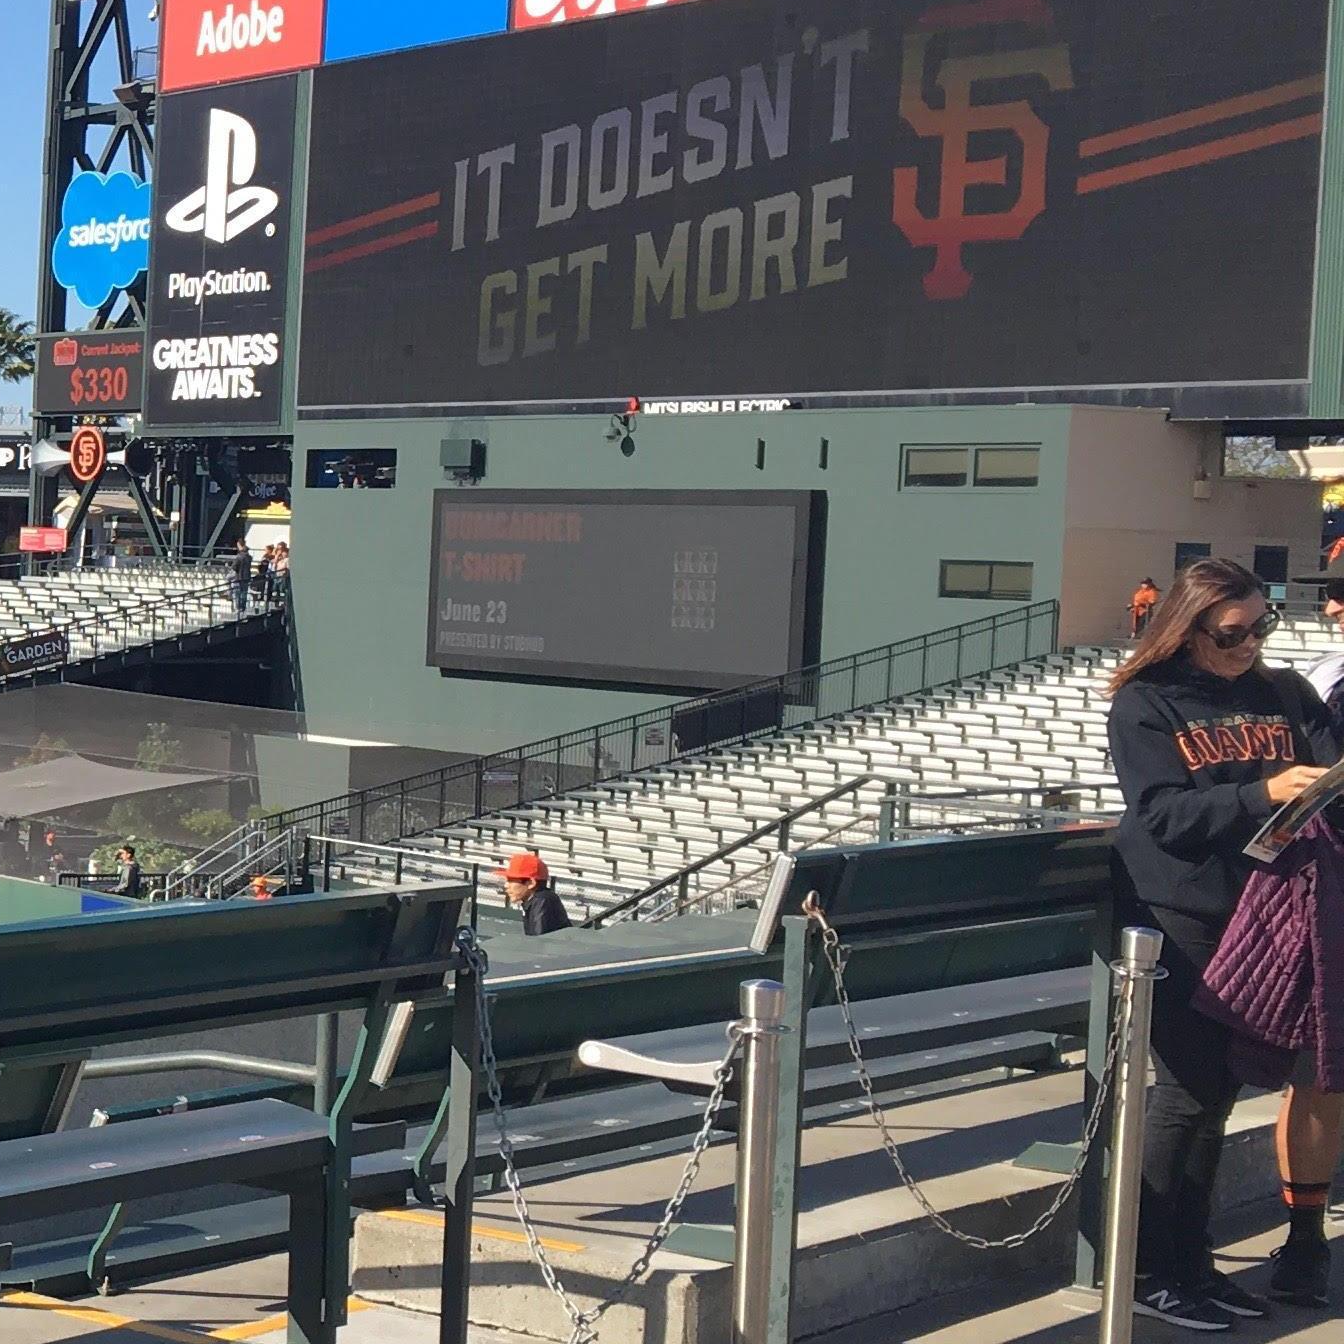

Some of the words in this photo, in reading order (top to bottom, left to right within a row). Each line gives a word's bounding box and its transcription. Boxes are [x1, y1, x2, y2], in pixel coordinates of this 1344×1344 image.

[450, 144, 515, 252] IT
[537, 27, 870, 230] DOESN'T
[69, 213, 150, 252] salesforc
[476, 244, 608, 367] GET
[631, 175, 854, 330] MORE
[153, 332, 278, 370] GREATNESS
[70, 366, 128, 405] $330
[441, 598, 481, 623] June
[486, 600, 508, 624] 23
[7, 640, 62, 663] GARDEN
